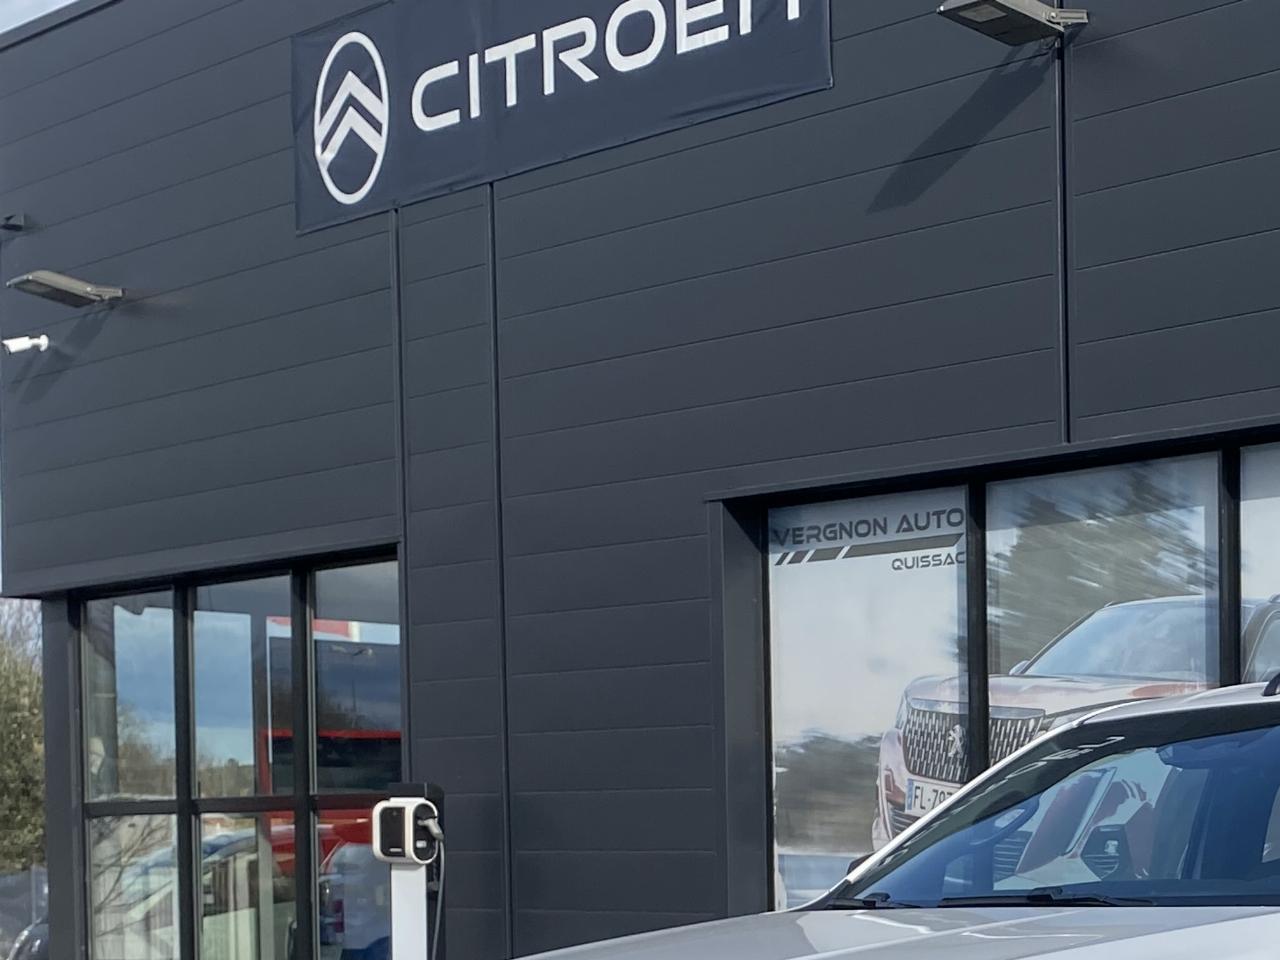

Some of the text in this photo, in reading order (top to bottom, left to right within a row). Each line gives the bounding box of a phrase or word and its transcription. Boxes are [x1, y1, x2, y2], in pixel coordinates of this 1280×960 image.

[773, 507, 965, 547] VERGNON AUTO
[891, 551, 966, 572] QUISSAC
